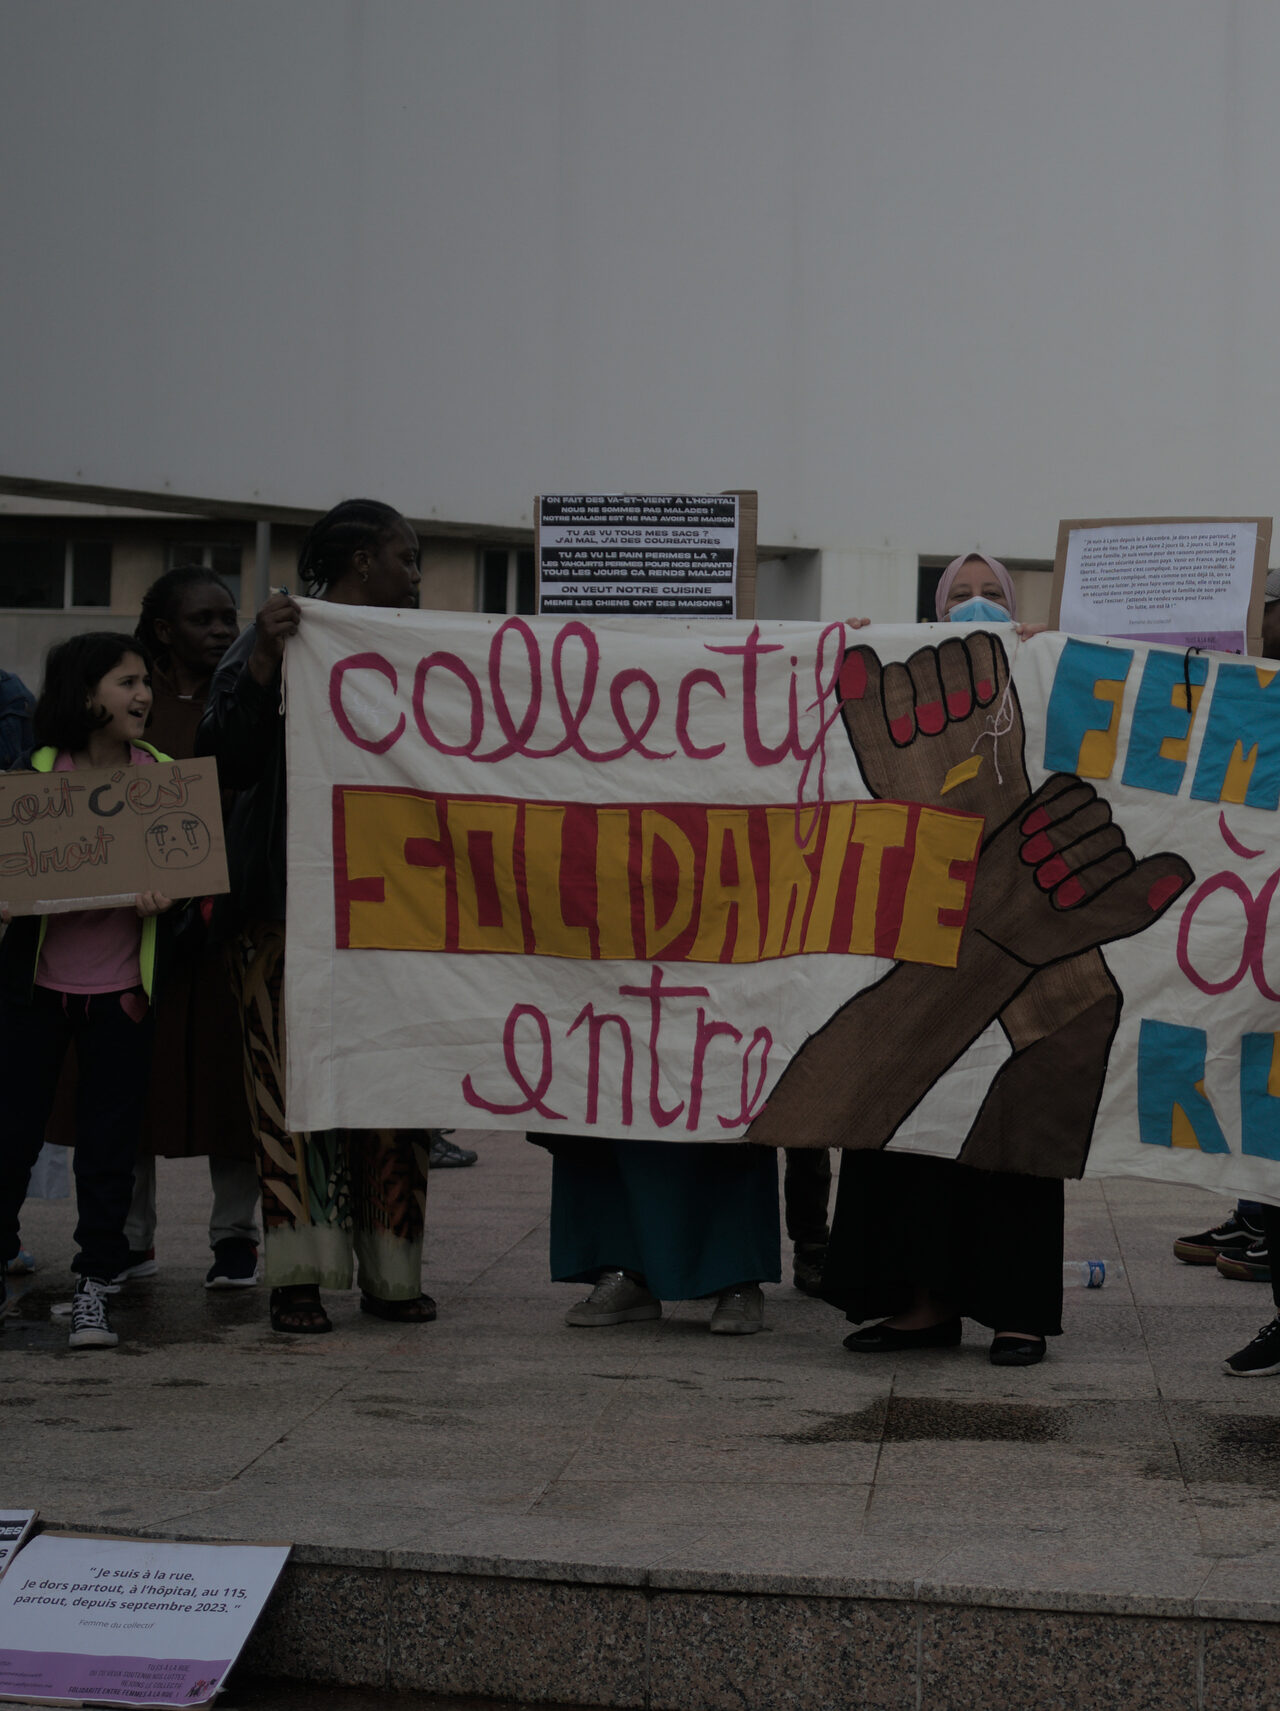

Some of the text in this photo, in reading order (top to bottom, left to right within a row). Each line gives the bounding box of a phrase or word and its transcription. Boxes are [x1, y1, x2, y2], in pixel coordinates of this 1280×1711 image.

[662, 586, 712, 594] CUISINE
[329, 616, 848, 848] collectif
[462, 965, 773, 1130] entre
[113, 1569, 140, 1579] suis
[142, 1570, 151, 1579] à
[153, 1570, 166, 1579] la
[169, 1572, 195, 1581] rue.
[20, 1580, 248, 1599] Je dors partout, à l'hôpital, au 115,
[13, 1596, 228, 1613] partout, depuis septembre 2023.
[79, 1619, 109, 1628] Femme
[122, 1622, 155, 1630] collectif
